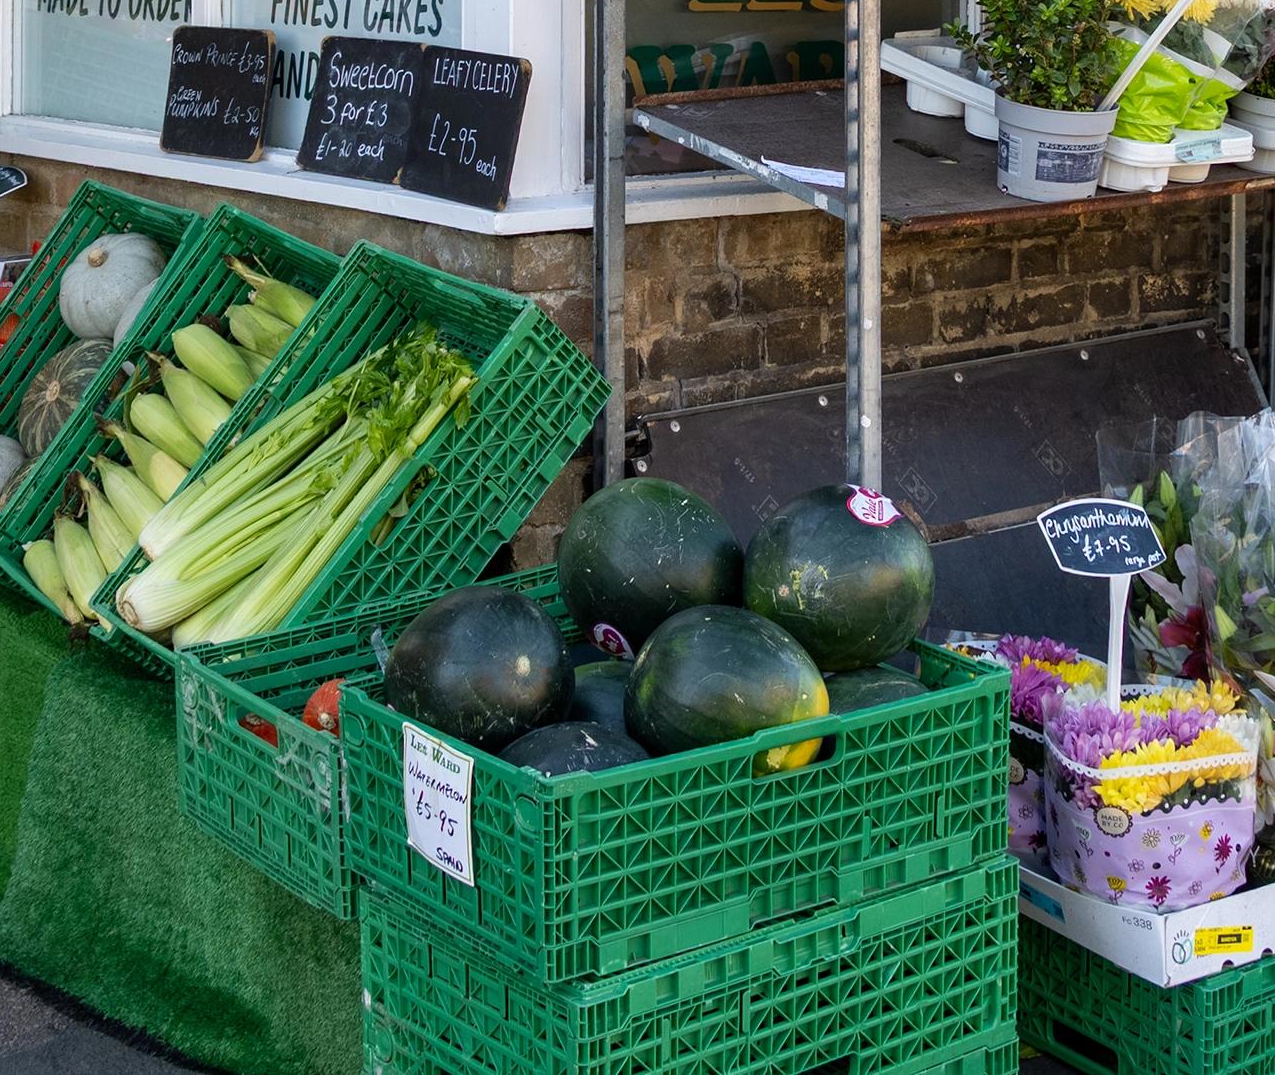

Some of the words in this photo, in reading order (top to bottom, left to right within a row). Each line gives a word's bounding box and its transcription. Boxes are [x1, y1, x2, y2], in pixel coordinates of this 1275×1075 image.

[271, 49, 322, 101] AND
[433, 57, 475, 89] LEAFY
[473, 59, 520, 99] CELERY
[320, 95, 338, 126] 3
[410, 733, 429, 756] LES
[431, 745, 461, 774] WARD
[1100, 814, 1124, 822] MADE
[1133, 915, 1154, 931] 338
